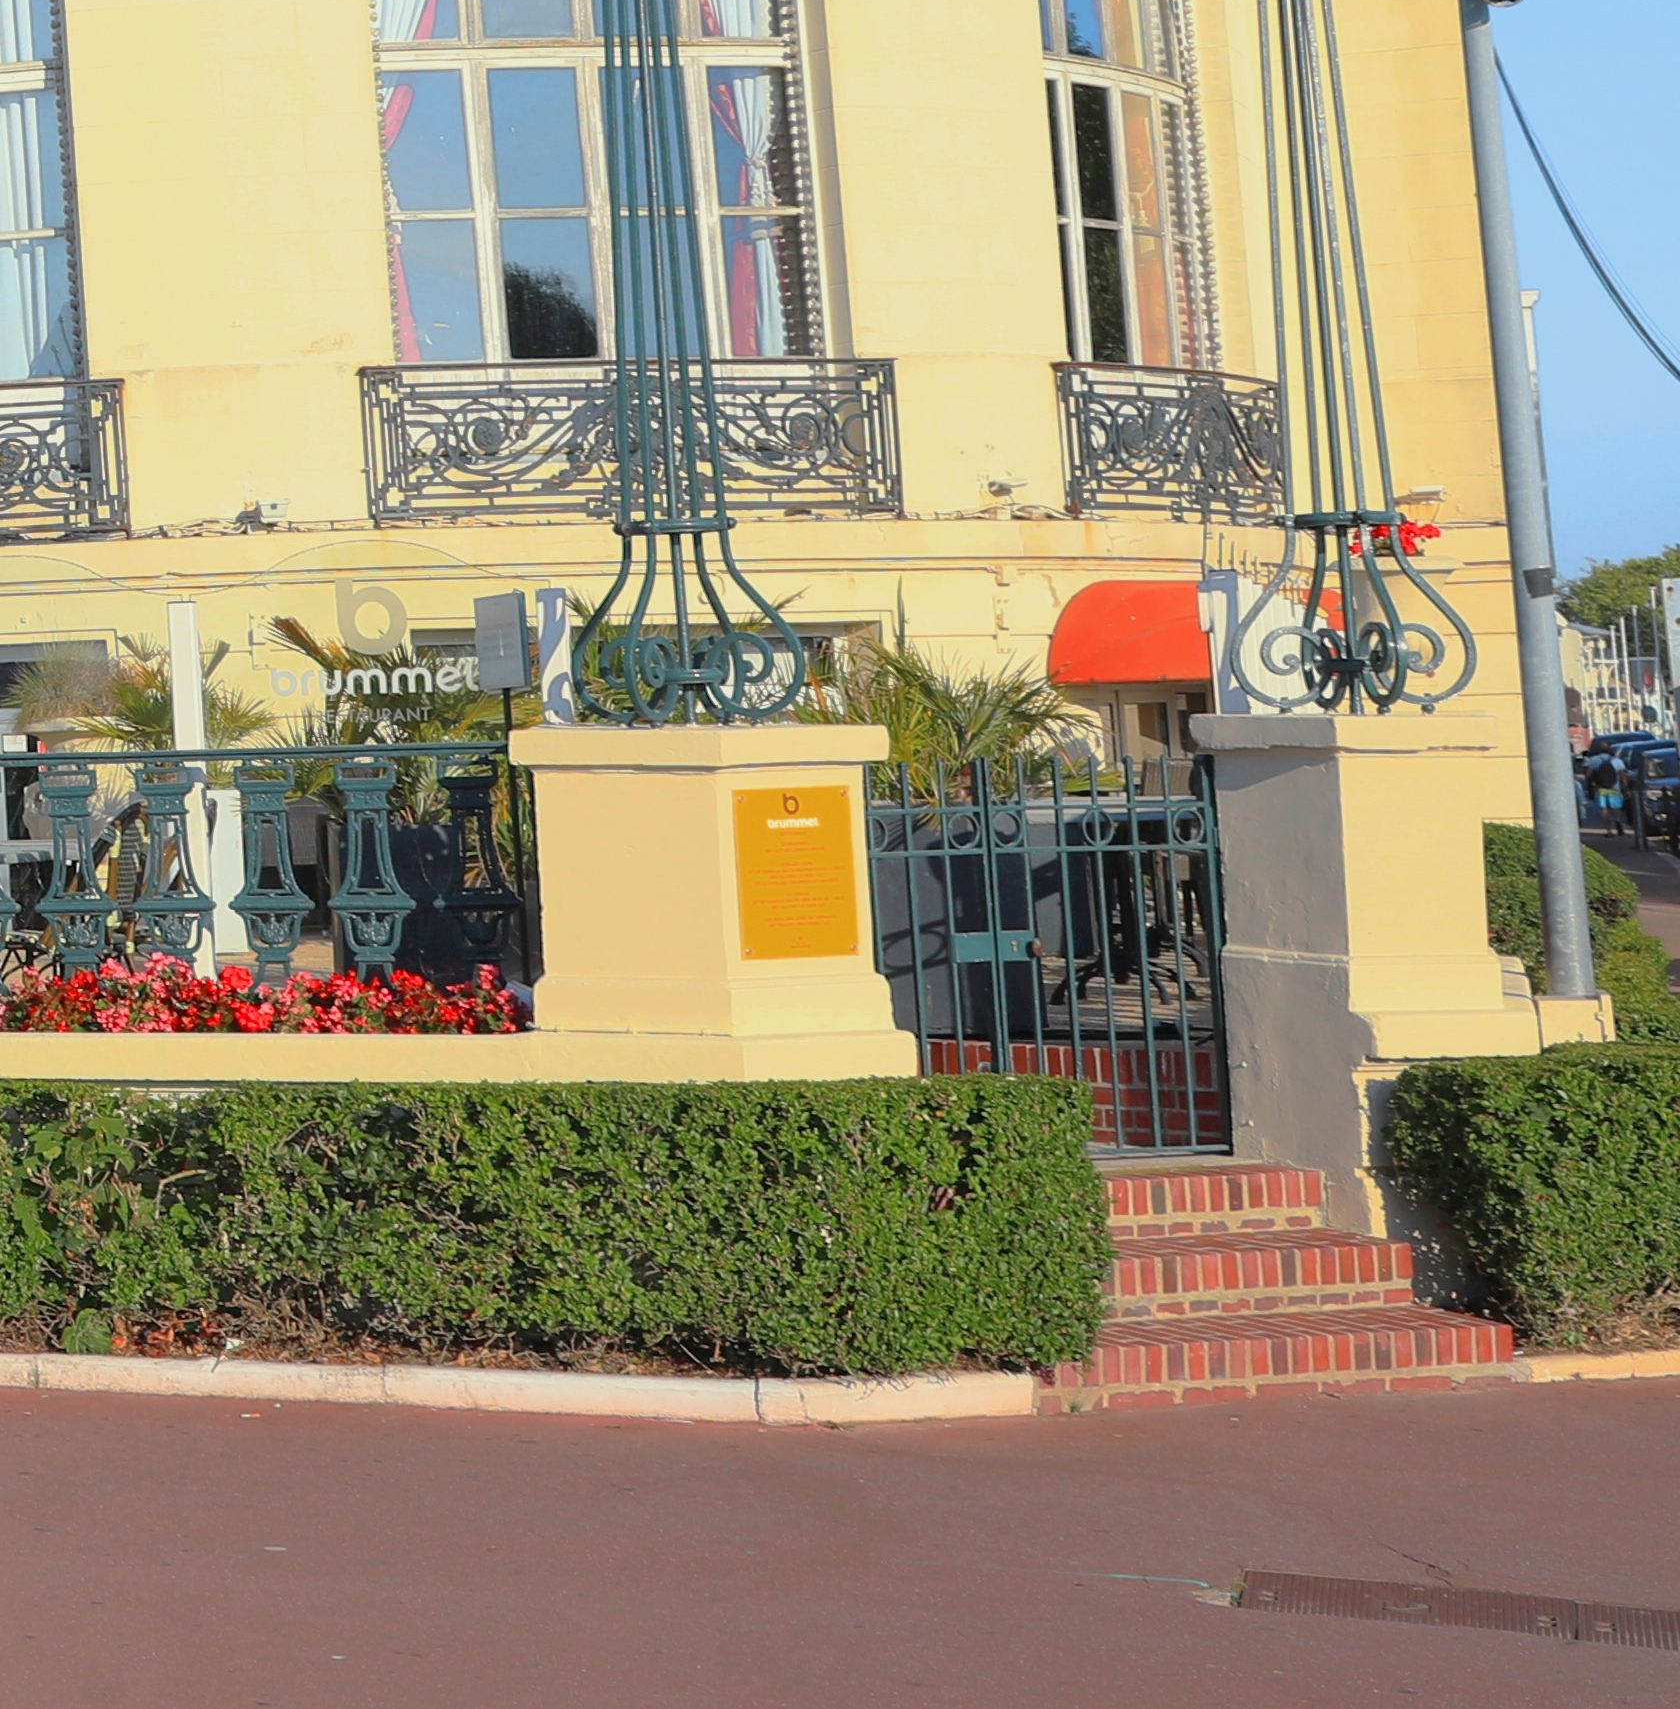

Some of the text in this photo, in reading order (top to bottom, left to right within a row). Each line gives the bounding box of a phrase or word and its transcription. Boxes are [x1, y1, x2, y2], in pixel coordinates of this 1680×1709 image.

[335, 578, 408, 656] b
[271, 664, 481, 697] brummel
[782, 792, 800, 815] b
[766, 817, 819, 829] brummel
